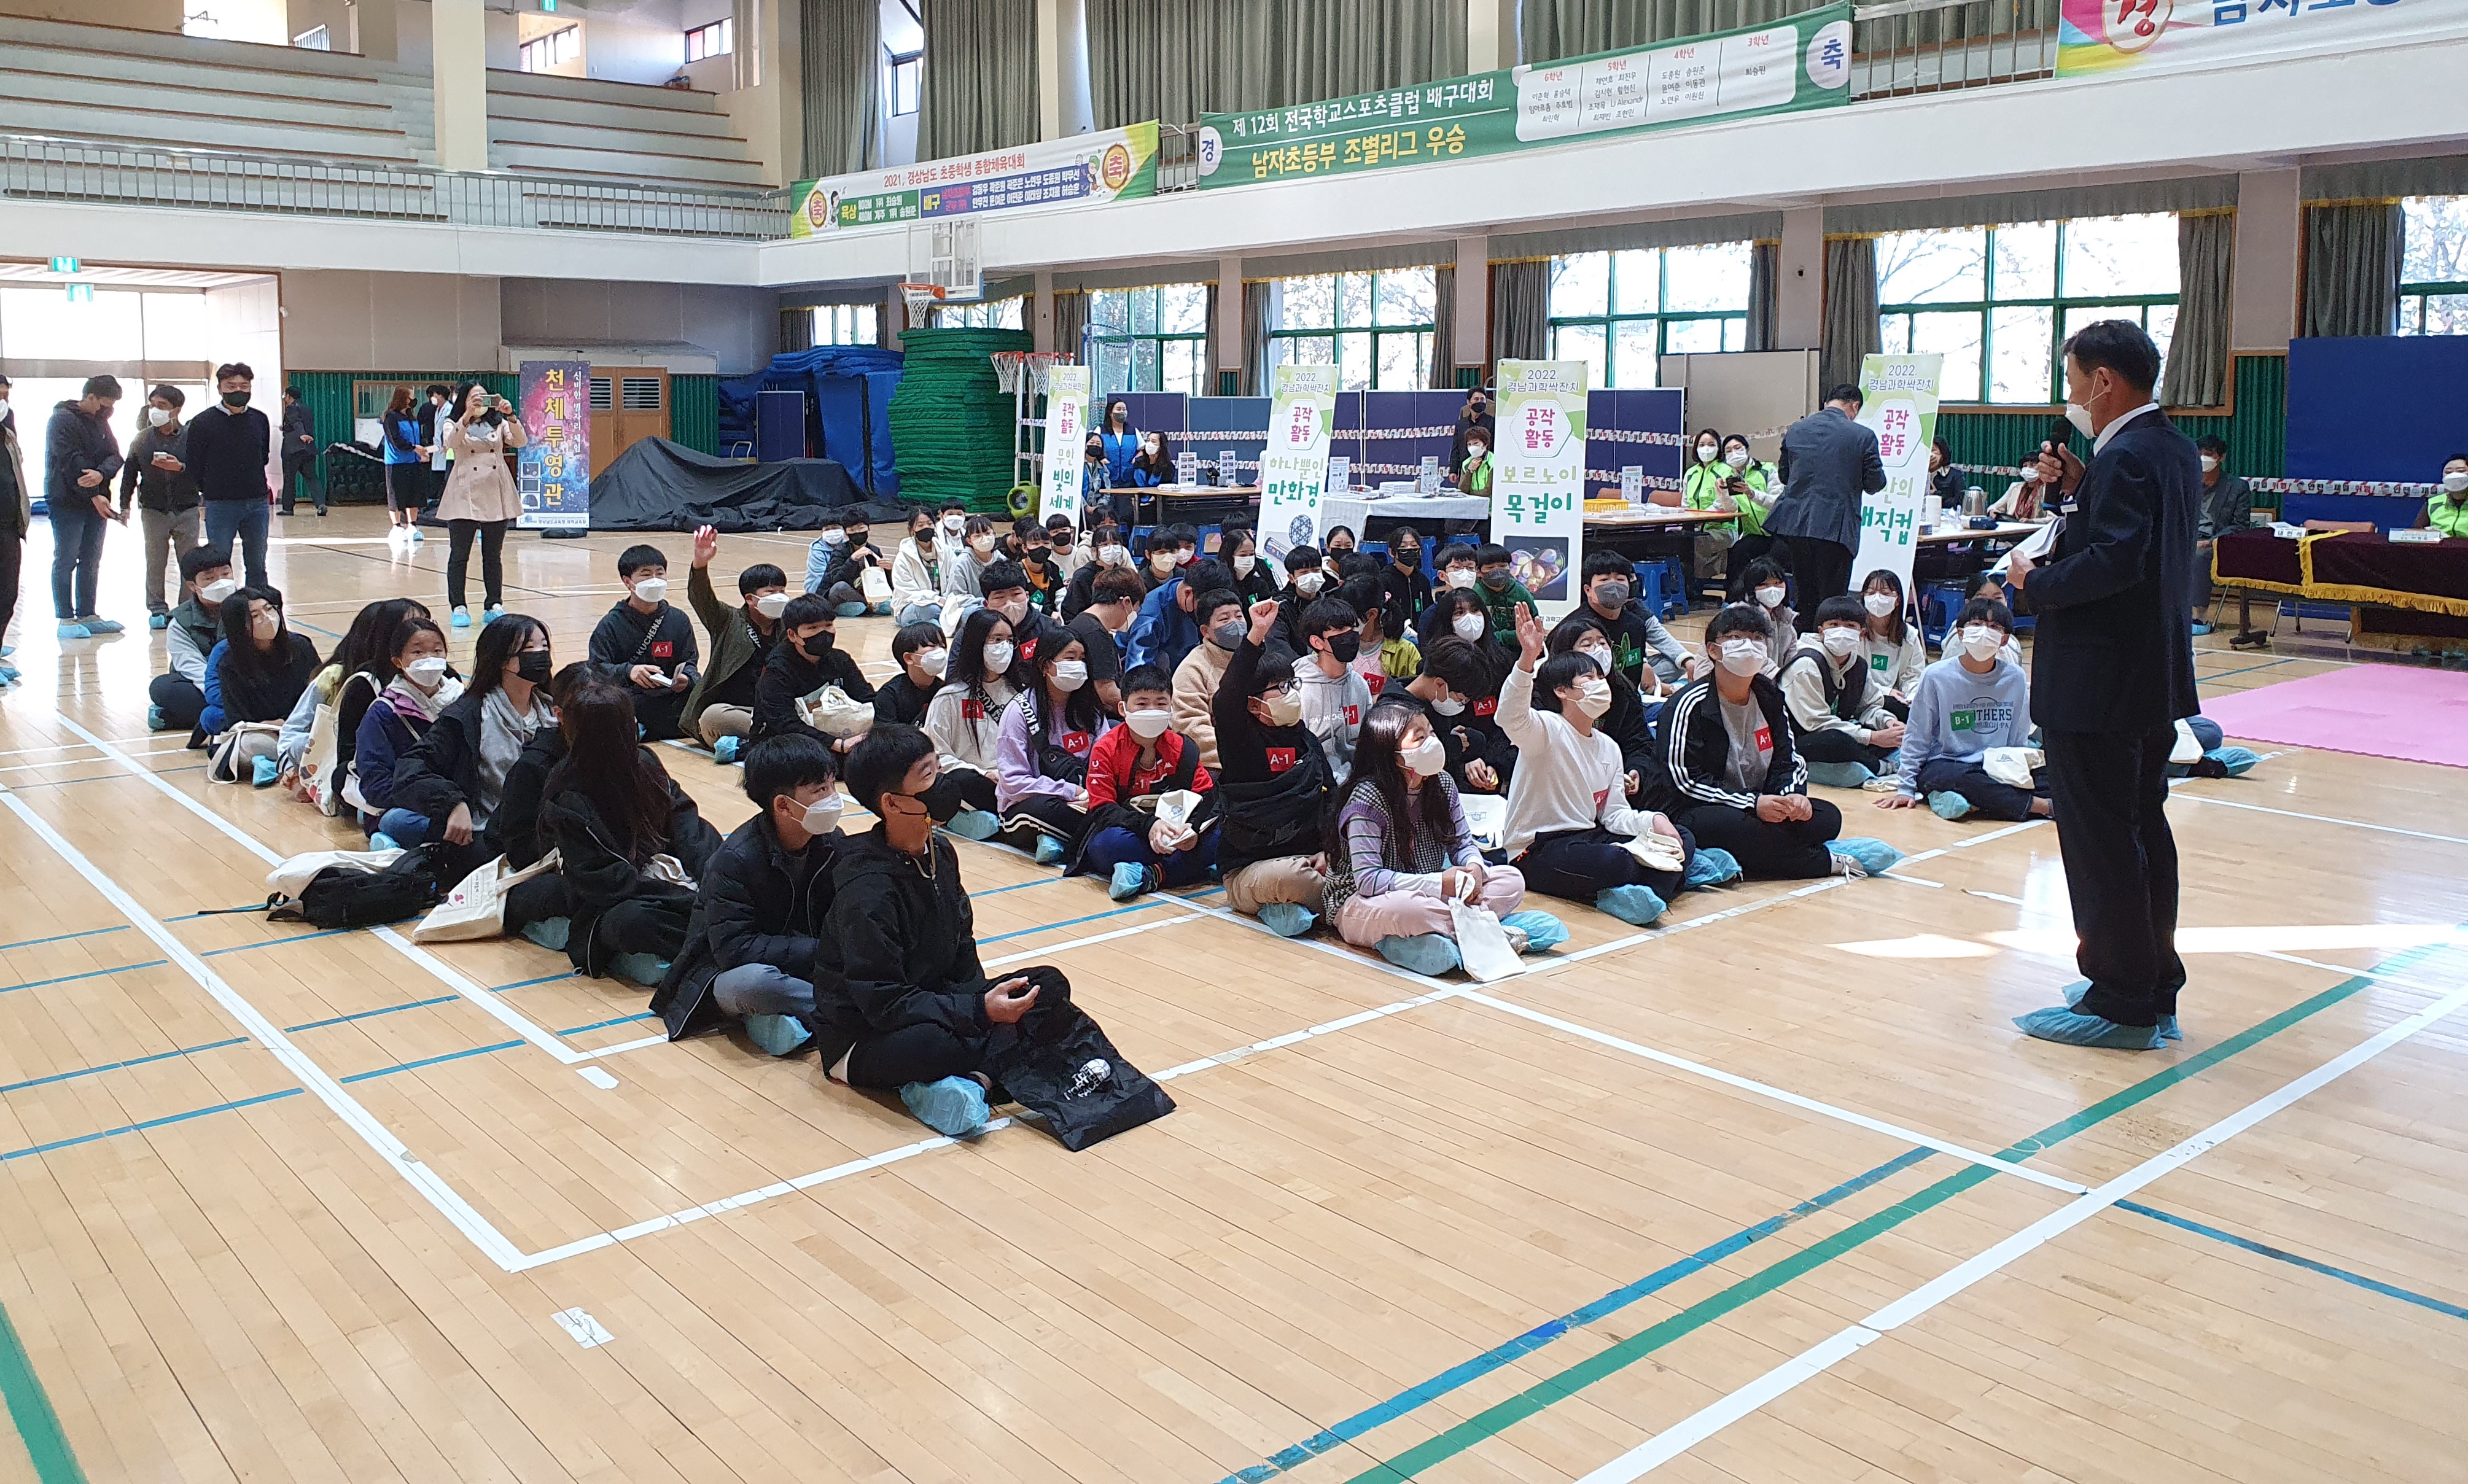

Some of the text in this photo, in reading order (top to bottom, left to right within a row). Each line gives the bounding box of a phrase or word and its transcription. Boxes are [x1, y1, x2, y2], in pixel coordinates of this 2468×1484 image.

[1747, 34, 1769, 46] 3학년
[1674, 47, 1694, 59] 4학년
[1821, 39, 1843, 69] 축
[1608, 59, 1626, 71] 5학년
[1544, 71, 1562, 81] 6학년
[1232, 78, 1494, 137] 제 12회 전국학교스포츠클럽 배구대회
[1201, 140, 1214, 162] 경
[1252, 124, 1466, 179] 남자초등부 조별리그 우승
[884, 152, 1025, 187] 2021, 경상남도 초중학생 종합체육대회
[1108, 154, 1123, 179] 축
[813, 200, 823, 219] 축
[924, 194, 940, 210] 배구
[841, 204, 857, 220] 육상
[1527, 369, 1559, 379] 2022.
[1889, 364, 1917, 376] 2022.
[1507, 381, 1579, 392] 경남과학싹잔치
[1869, 379, 1934, 390] 경남과학싹잔치
[1062, 403, 1075, 416] 공작
[1293, 406, 1313, 422] 공작
[1526, 408, 1555, 426] 공작
[1061, 419, 1073, 434] 활동
[1884, 410, 1909, 429] 공작
[543, 368, 564, 505] 천체투영관
[1290, 424, 1310, 442] 활동
[1525, 429, 1554, 449] 활동
[1880, 433, 1905, 456] 활동
[1056, 448, 1074, 466] 무한
[1269, 456, 1323, 480] 하나뿐인
[1500, 465, 1576, 484] 보르노이
[1053, 468, 1074, 492] 빛의
[1267, 480, 1319, 508] 만화경
[1049, 495, 1073, 510] 세계
[1503, 493, 1571, 524] 목걸이
[1874, 656, 1884, 666] B-1
[1366, 678, 1379, 688] A-1
[1477, 700, 1493, 710] A-1
[1955, 715, 1969, 725] B-1
[1974, 709, 2012, 721] THERS
[1067, 736, 1084, 748] A-1
[1760, 732, 1770, 745] A-1
[1270, 754, 1289, 764] A-1
